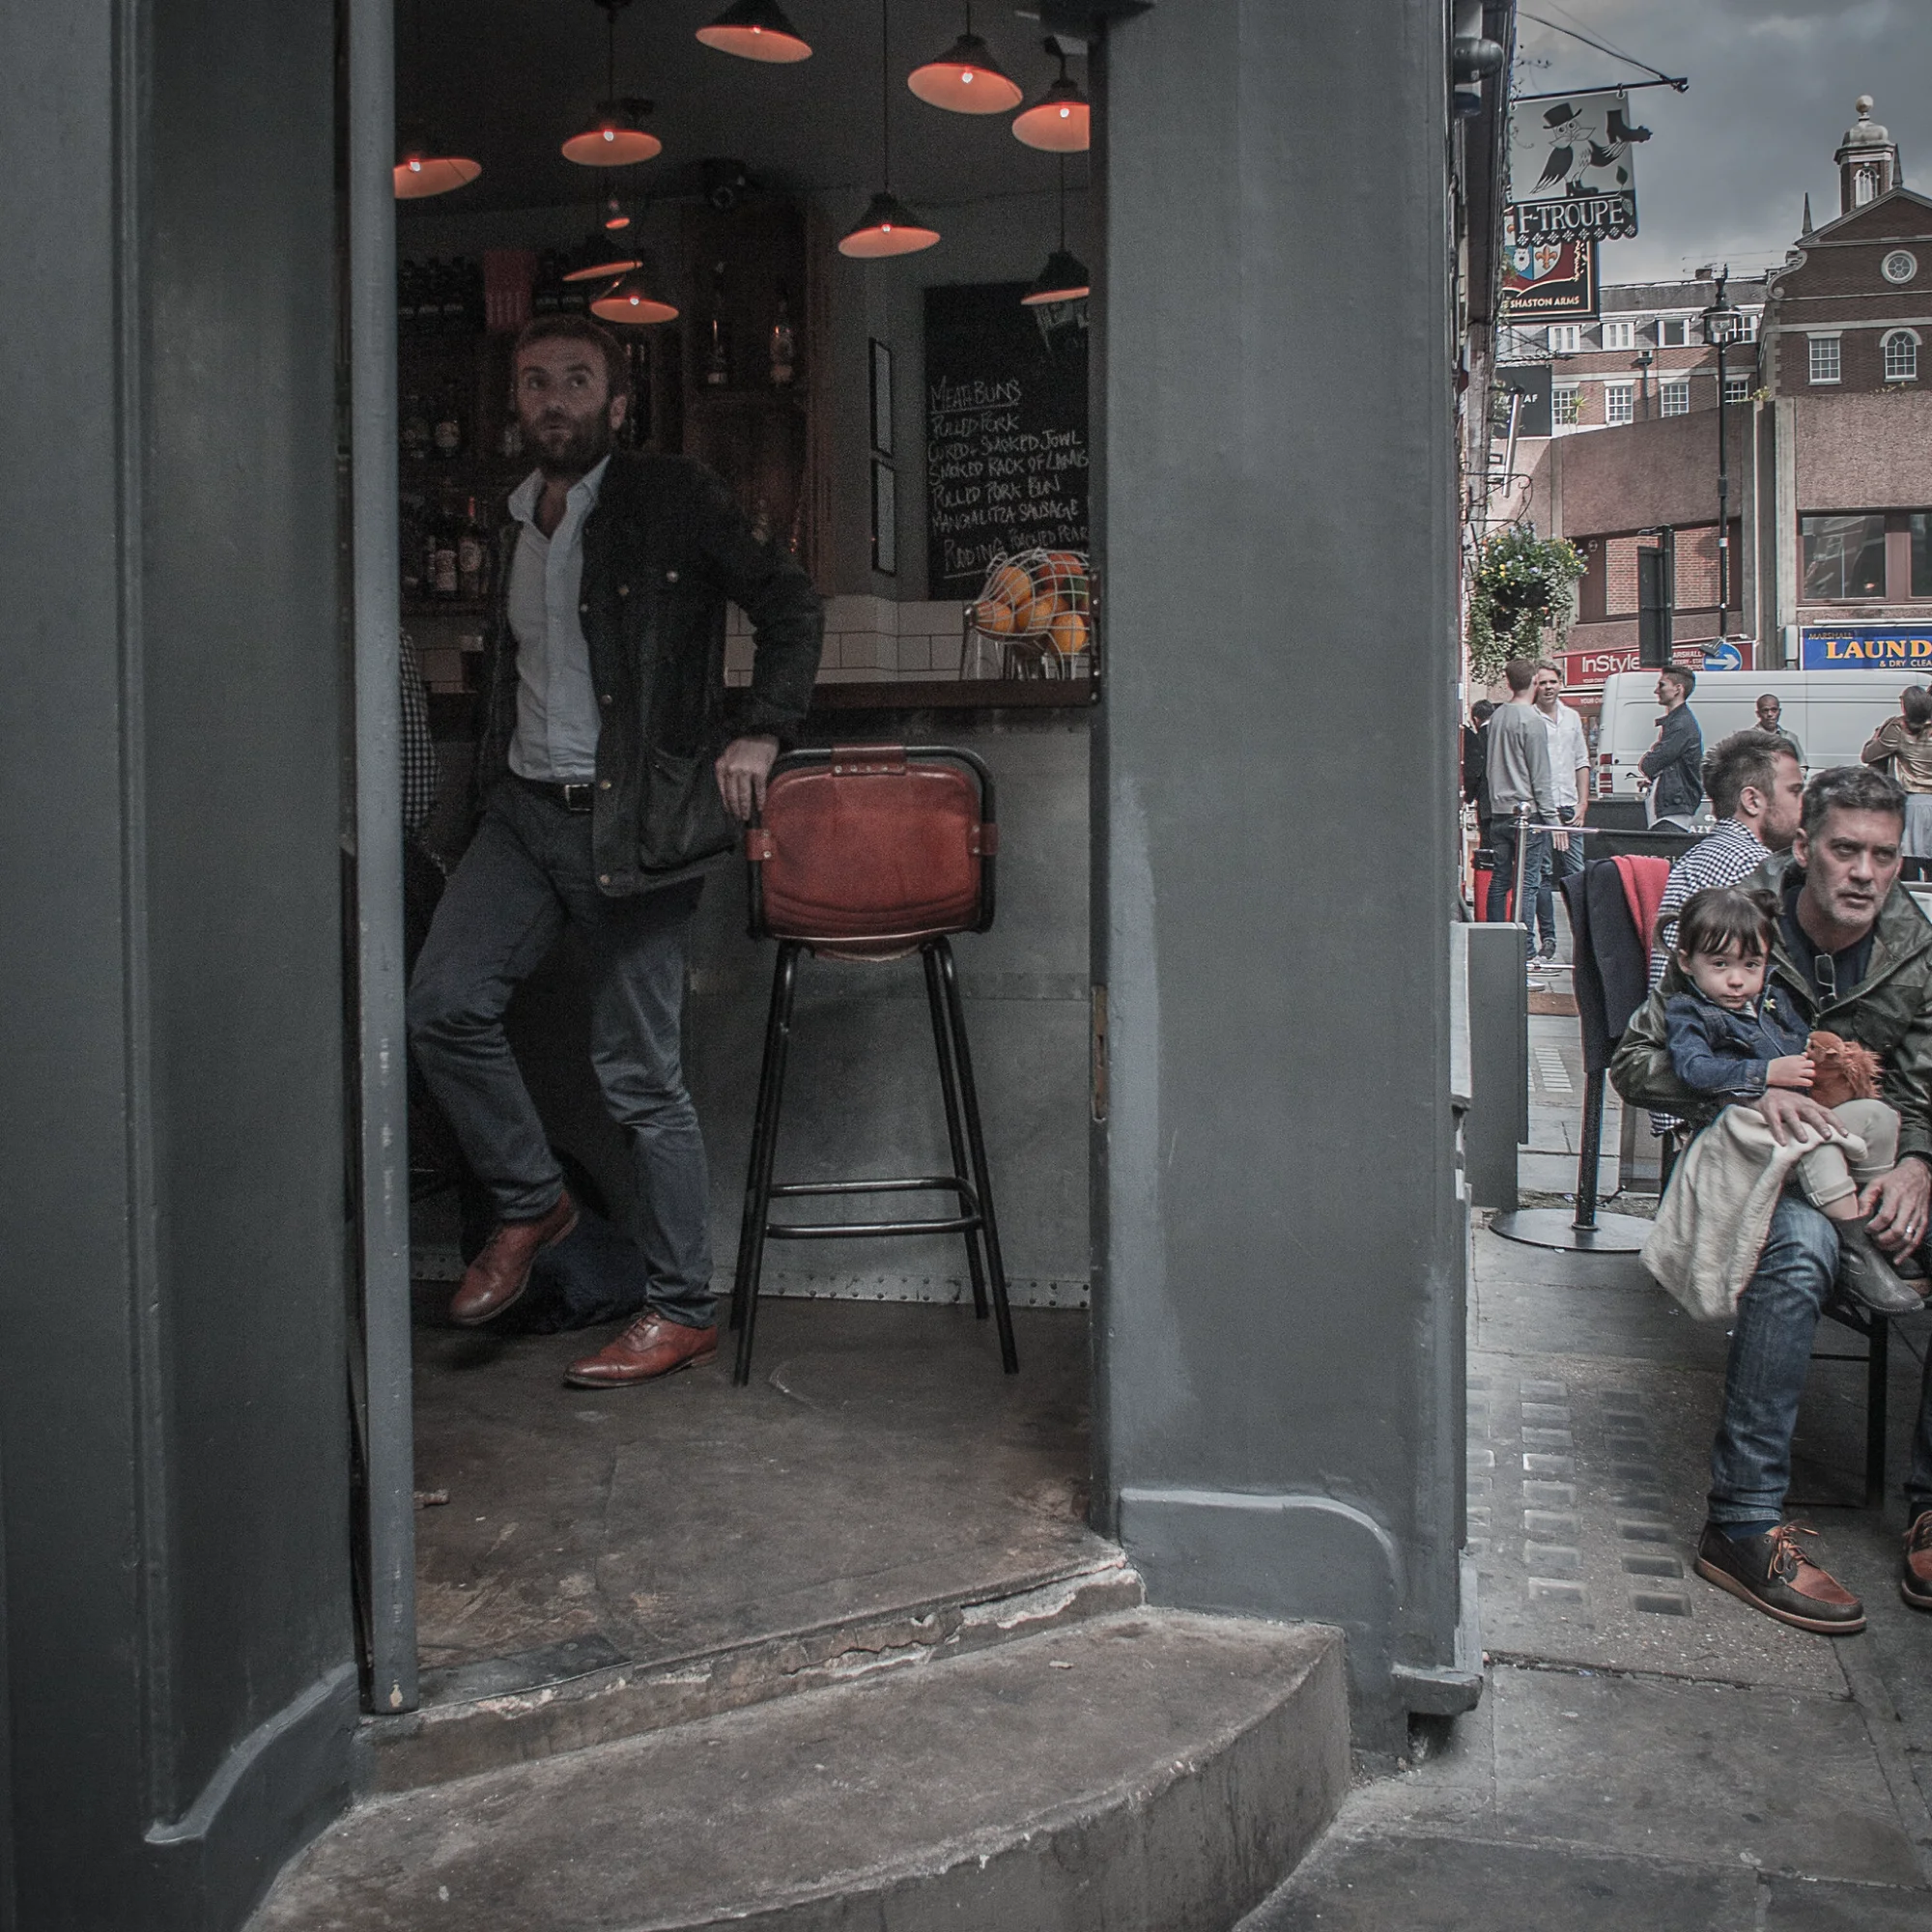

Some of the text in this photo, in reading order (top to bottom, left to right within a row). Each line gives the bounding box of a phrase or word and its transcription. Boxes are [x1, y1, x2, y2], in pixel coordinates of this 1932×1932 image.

[1516, 198, 1624, 234] F-TROUPE
[1510, 298, 1552, 309] SHASTON
[1554, 296, 1579, 306] ARMS
[973, 378, 1024, 406] BUNS
[980, 411, 1020, 434] PORK
[1039, 429, 1083, 450] JOWL
[927, 461, 983, 486] SMOKED
[987, 457, 1025, 477] RACK
[1027, 453, 1045, 473] OF
[984, 480, 1023, 504] PORK
[1028, 473, 1061, 498] BUN
[1018, 497, 1079, 524] SAUSAGE
[1808, 632, 1854, 640] MARSHALL
[1672, 650, 1702, 659] ARSHALL
[1826, 639, 1932, 660] LAUND
[1581, 654, 1640, 673] InStyle
[1689, 825, 1711, 834] AZY
